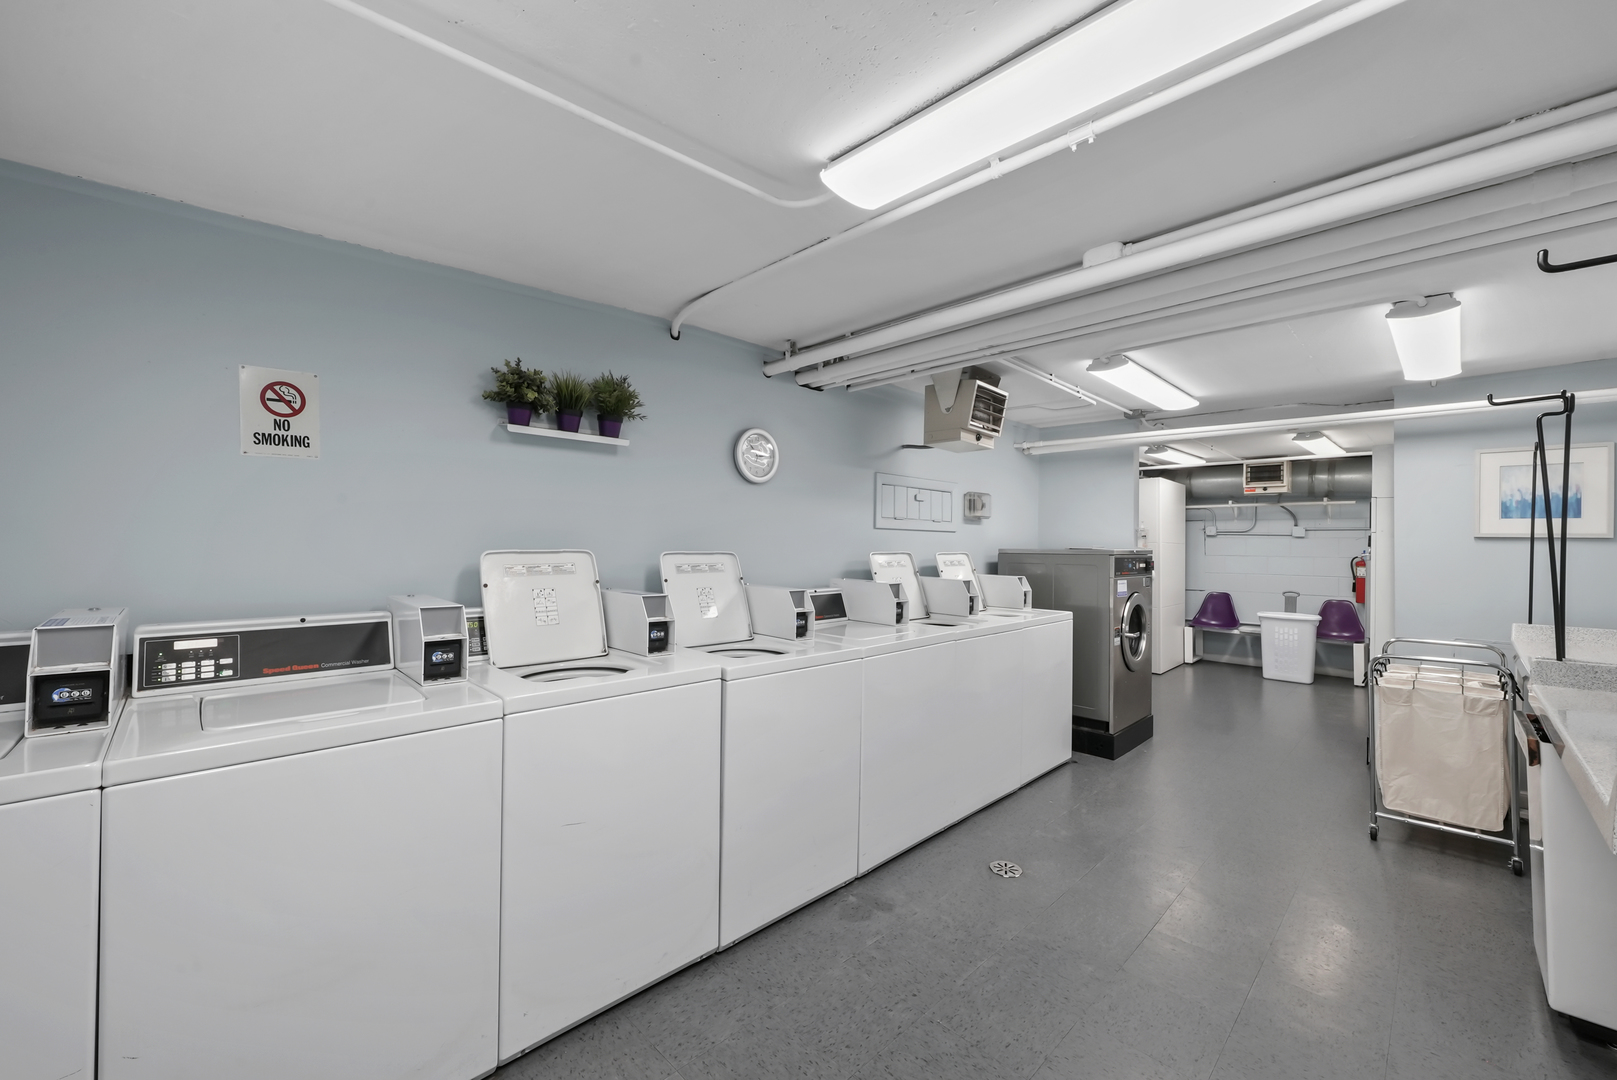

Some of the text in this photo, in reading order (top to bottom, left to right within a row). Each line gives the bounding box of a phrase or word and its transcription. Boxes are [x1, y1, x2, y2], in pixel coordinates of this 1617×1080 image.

[273, 418, 291, 432] NO
[253, 432, 310, 448] SMOKING
[262, 665, 291, 674] Speed
[292, 663, 319, 671] Queen
[321, 660, 351, 668] Commercial
